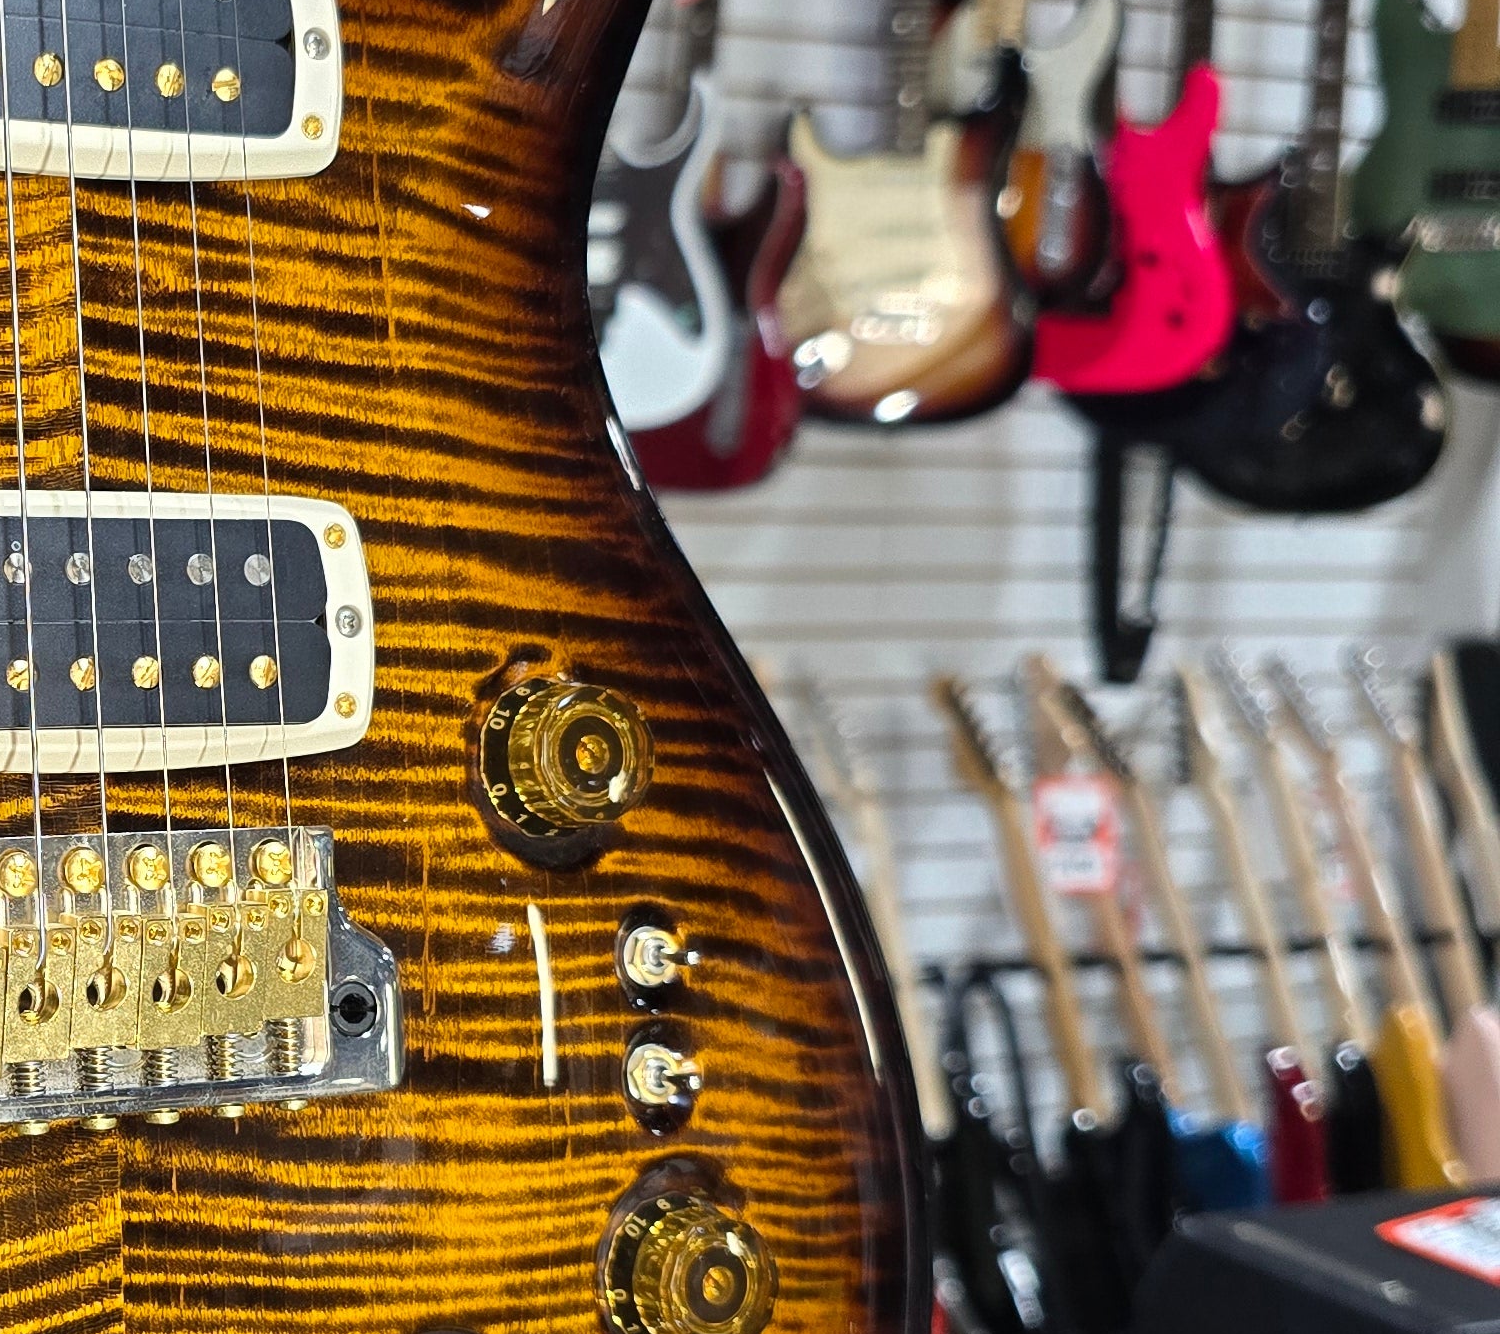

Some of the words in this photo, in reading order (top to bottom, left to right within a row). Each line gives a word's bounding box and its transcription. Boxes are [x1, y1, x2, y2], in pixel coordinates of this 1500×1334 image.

[490, 710, 510, 730] 10
[491, 783, 507, 796] 0
[516, 814, 528, 824] 1
[625, 1215, 647, 1238] 10
[612, 1288, 627, 1301] 0
[627, 1322, 640, 1332] 1
